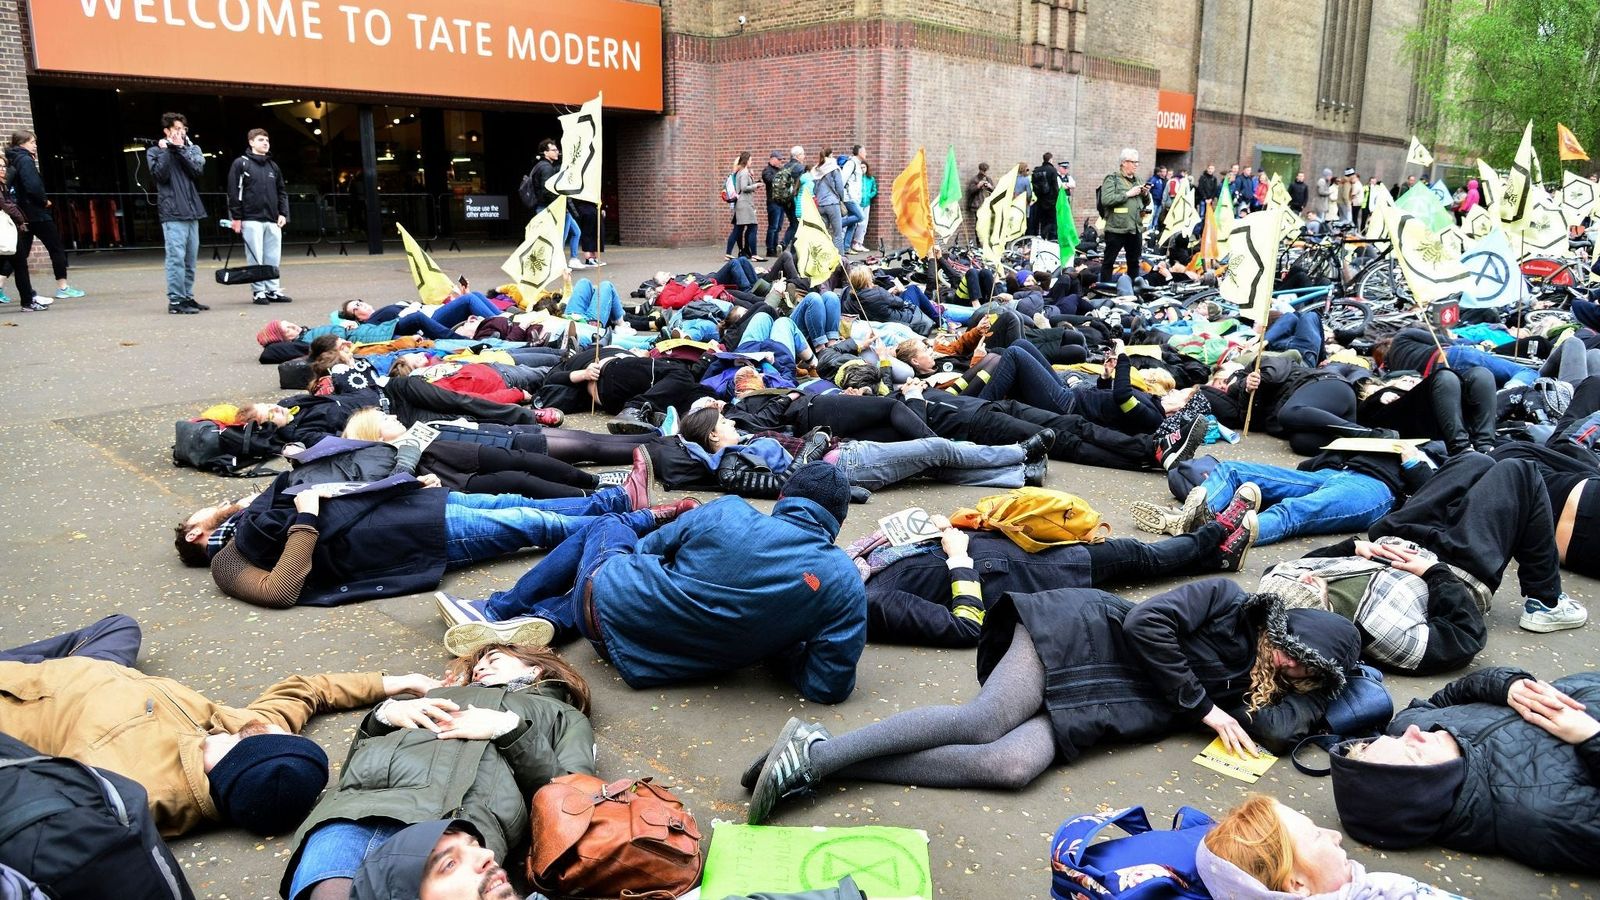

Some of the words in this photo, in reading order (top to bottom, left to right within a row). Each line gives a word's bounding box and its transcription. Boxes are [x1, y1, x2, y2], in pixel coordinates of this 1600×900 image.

[338, 4, 391, 46] TO
[406, 12, 493, 57] TATE
[507, 25, 641, 72] MODERN
[1156, 110, 1186, 130] ODERN
